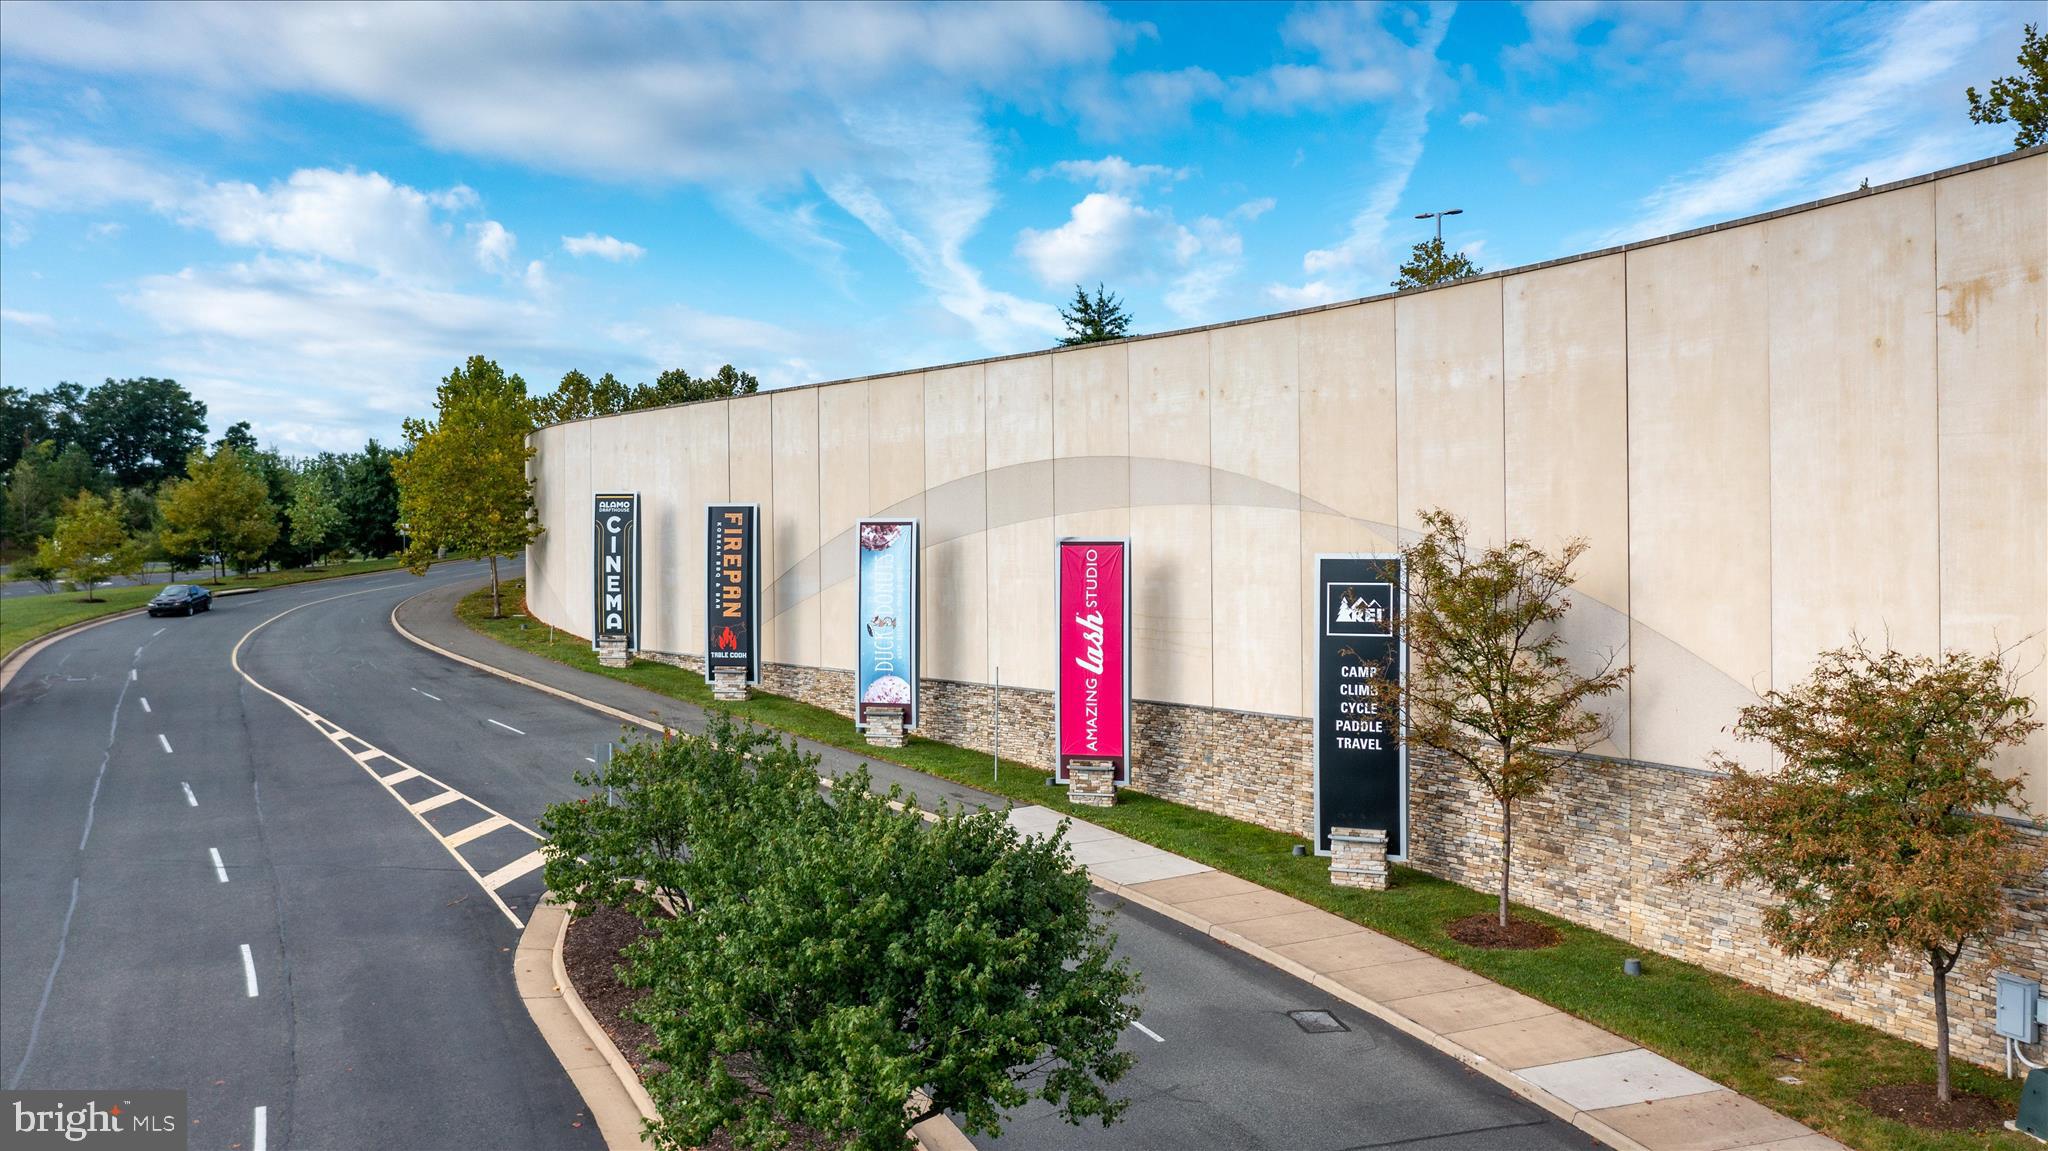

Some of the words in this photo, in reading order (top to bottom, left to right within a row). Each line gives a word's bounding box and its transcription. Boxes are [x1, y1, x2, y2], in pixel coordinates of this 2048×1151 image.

[606, 516, 622, 630] CINEMA
[722, 512, 744, 618] FIREPAN
[874, 553, 894, 615] DONUTS
[1085, 549, 1098, 608] STUDIO
[729, 651, 747, 659] COOK
[874, 629, 894, 672] DUCK
[1075, 609, 1104, 676] lash
[1341, 665, 1377, 678] CAMP
[1085, 677, 1098, 752] AMAZING
[1335, 719, 1383, 733] PADDLE
[1340, 701, 1378, 715] CYCLE
[1336, 736, 1382, 751] TRAVEL
